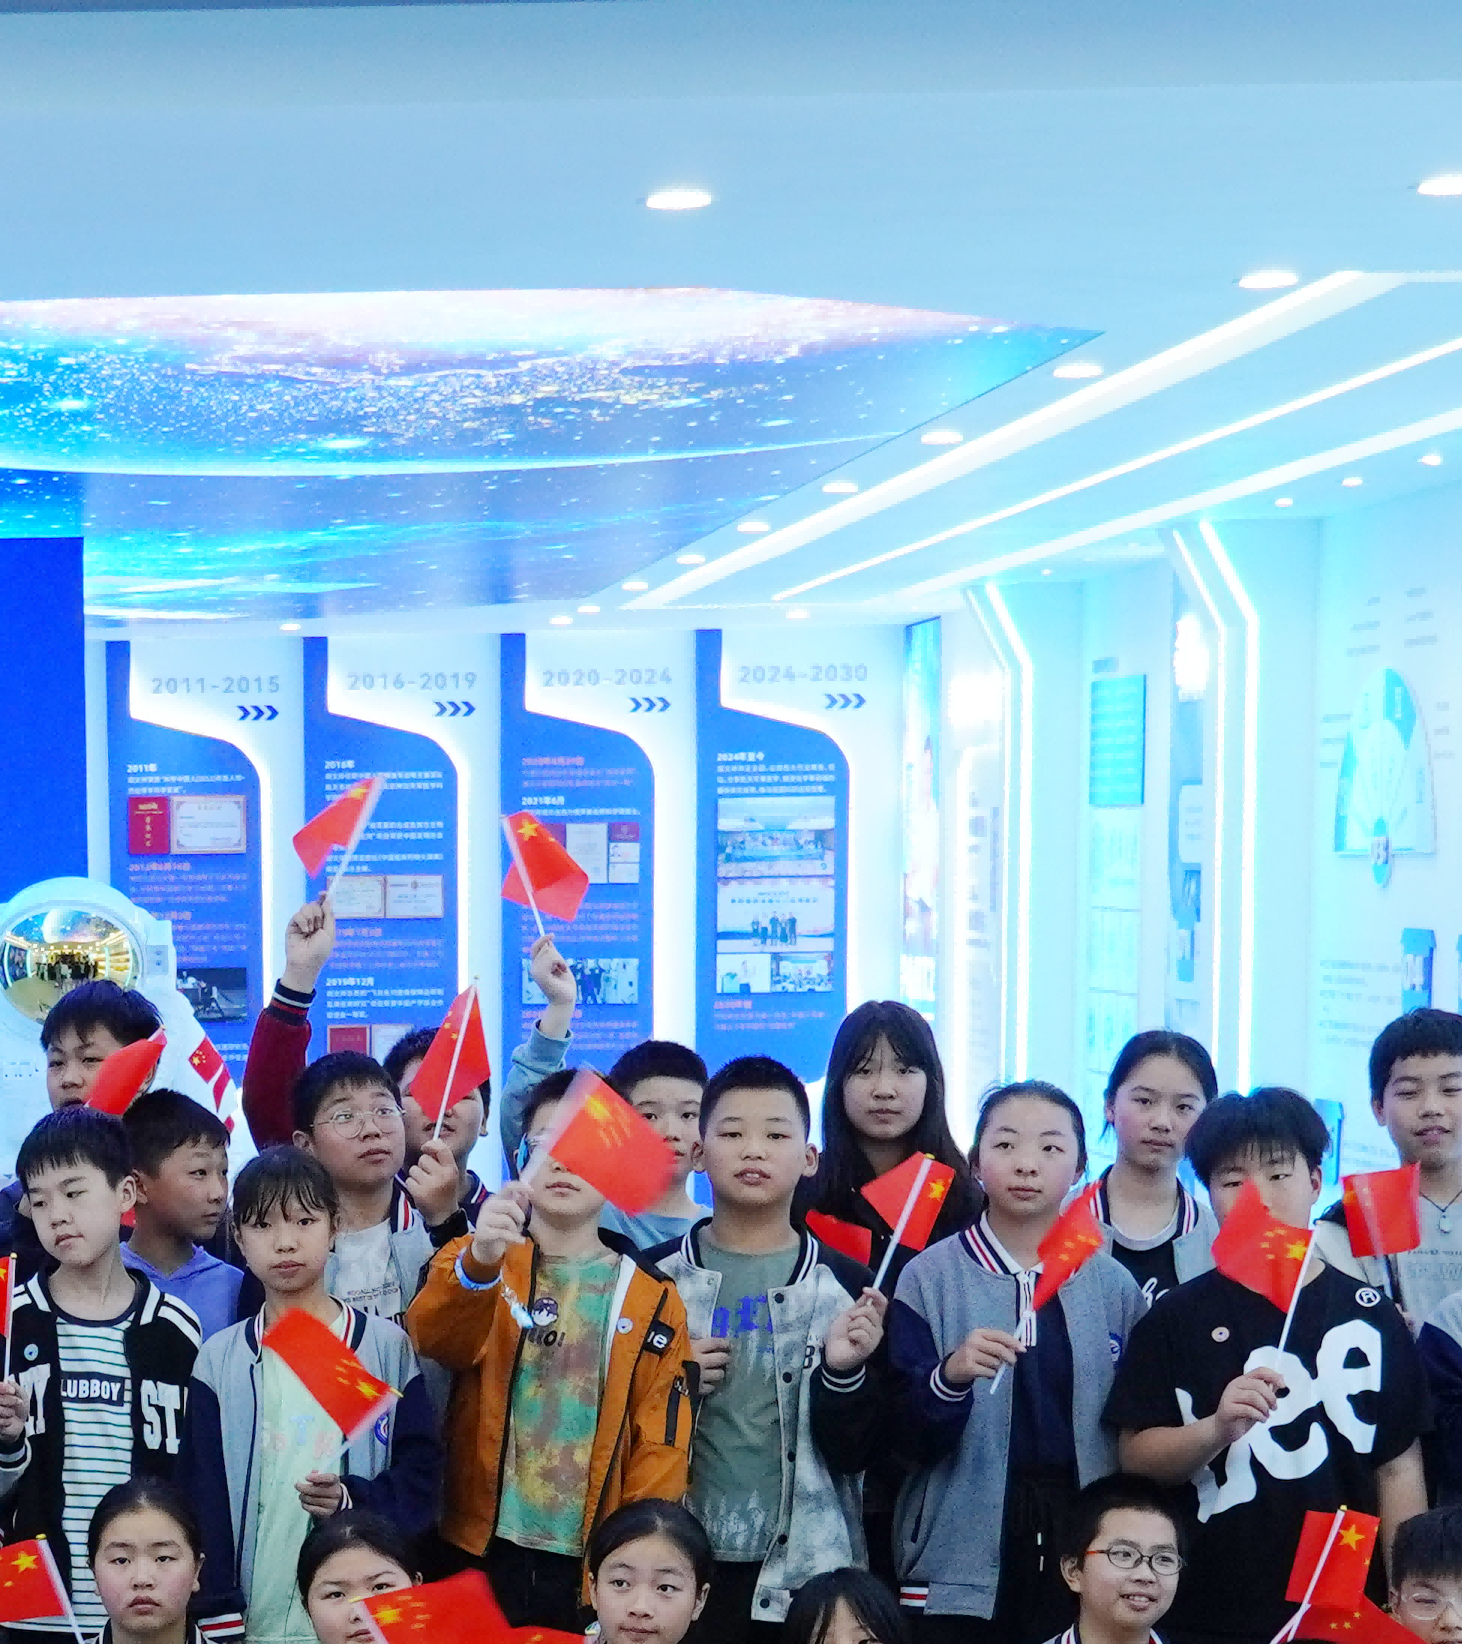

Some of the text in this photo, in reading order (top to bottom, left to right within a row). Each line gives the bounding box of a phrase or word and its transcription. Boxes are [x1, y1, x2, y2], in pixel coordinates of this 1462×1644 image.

[348, 672, 477, 690] 2016-2019
[543, 667, 672, 687] 2020-2024
[738, 663, 868, 683] 2024-2030
[151, 675, 280, 694] 2011-2015
[140, 1379, 188, 1454] ST
